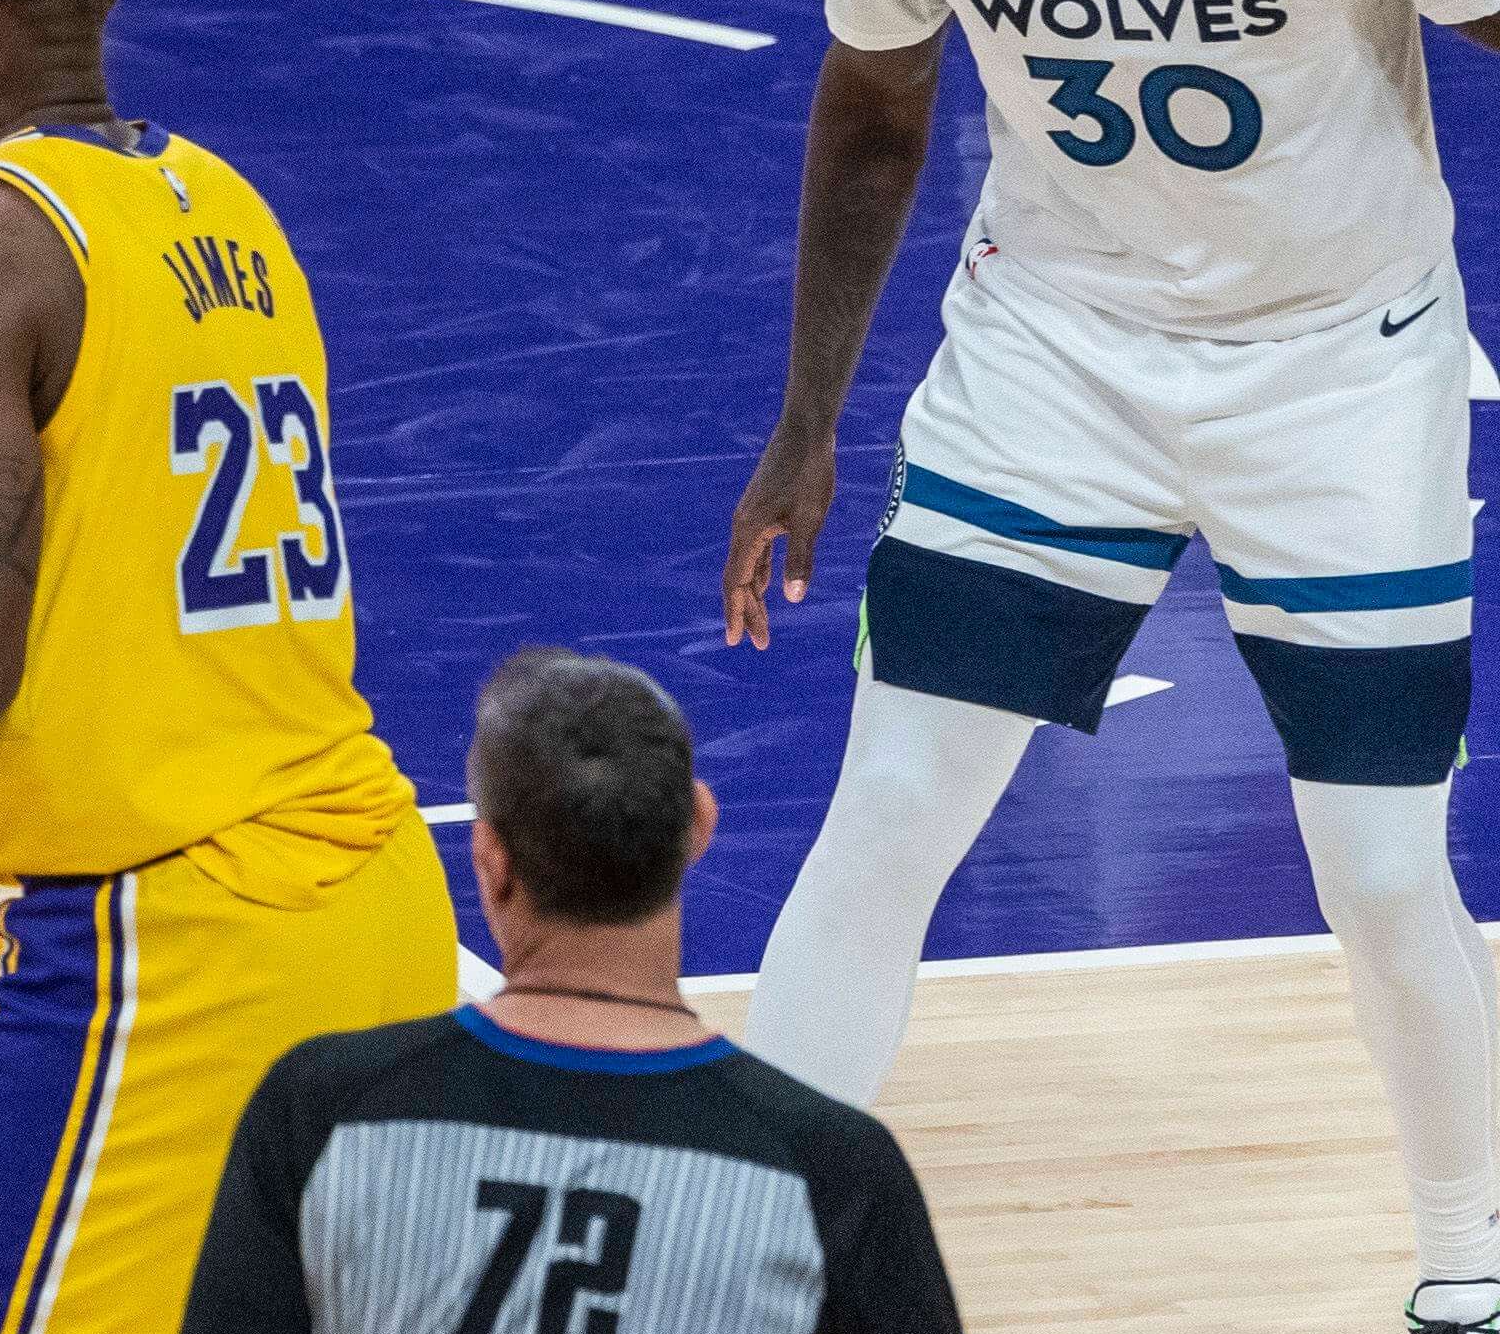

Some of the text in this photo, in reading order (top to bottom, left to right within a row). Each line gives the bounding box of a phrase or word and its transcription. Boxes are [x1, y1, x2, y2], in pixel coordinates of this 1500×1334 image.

[1023, 54, 1263, 173] 30
[162, 235, 275, 324] JAMES
[170, 373, 350, 635] 23
